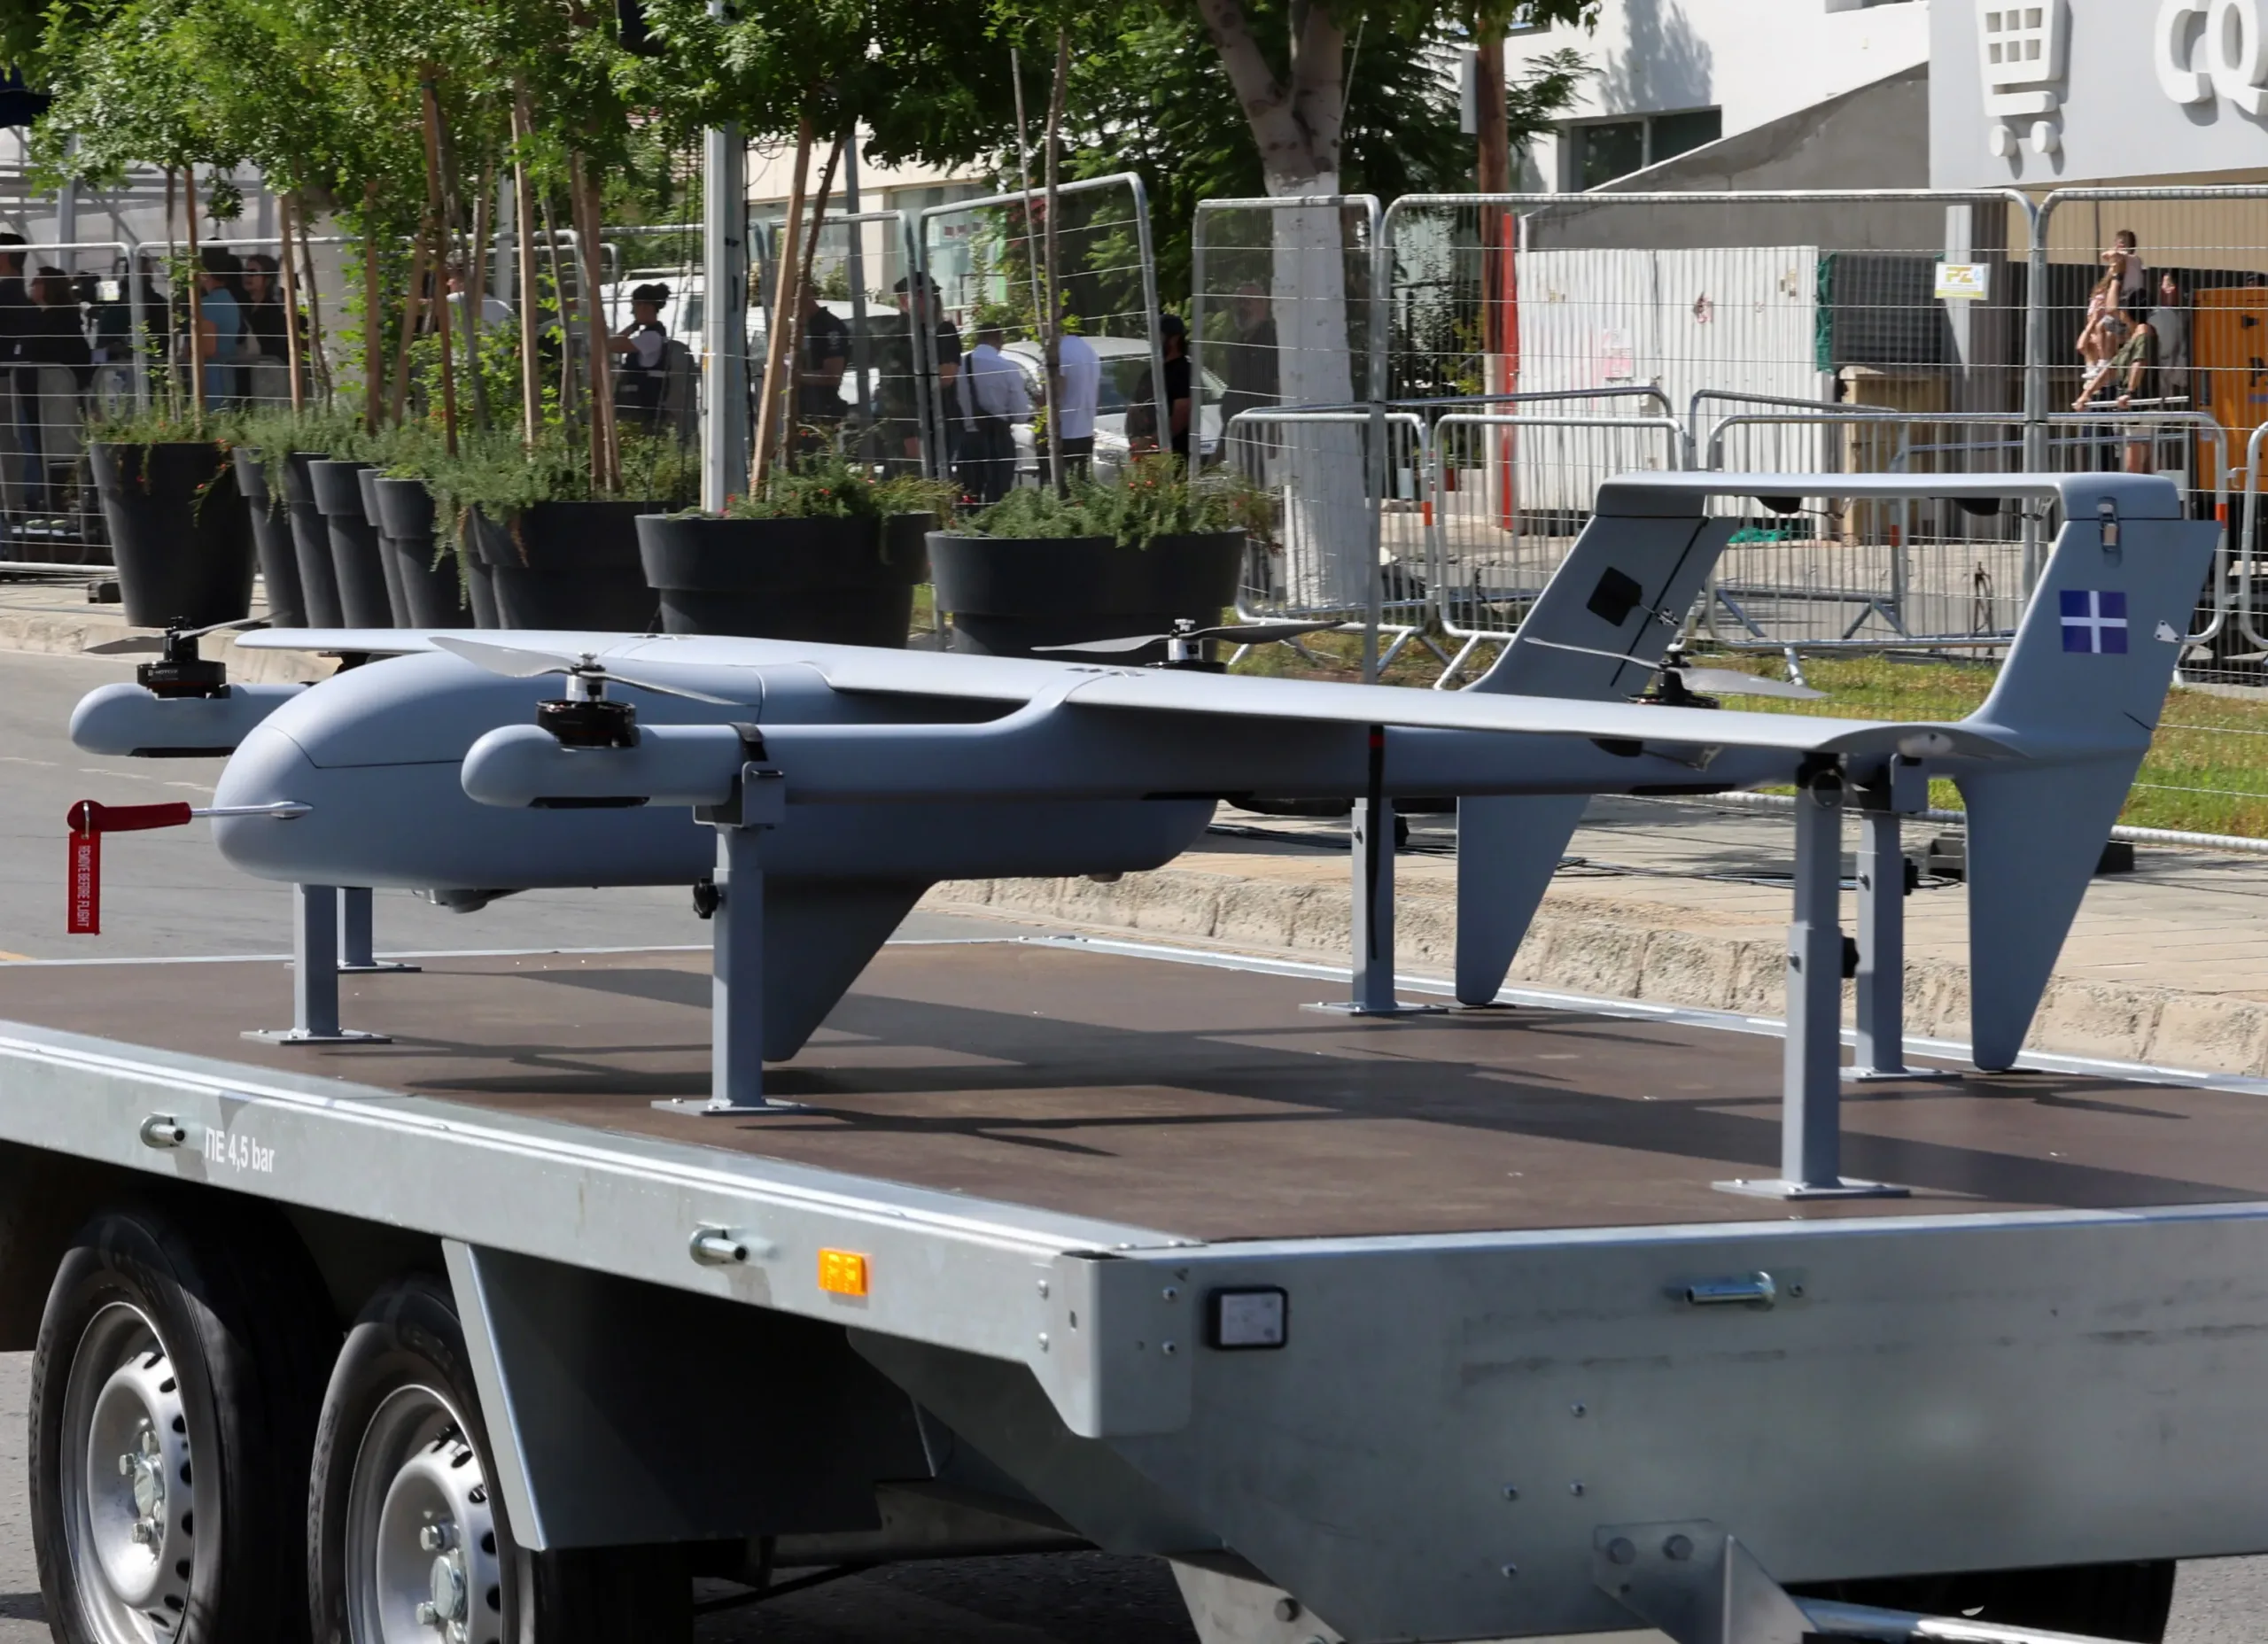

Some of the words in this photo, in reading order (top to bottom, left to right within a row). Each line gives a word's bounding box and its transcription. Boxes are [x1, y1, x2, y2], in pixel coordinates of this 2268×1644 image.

[77, 845, 91, 872] REMOVE
[77, 872, 90, 899] BEFORE
[77, 900, 89, 927] FLIGHT
[228, 1134, 249, 1173] 4,5
[252, 1137, 275, 1173] bar
